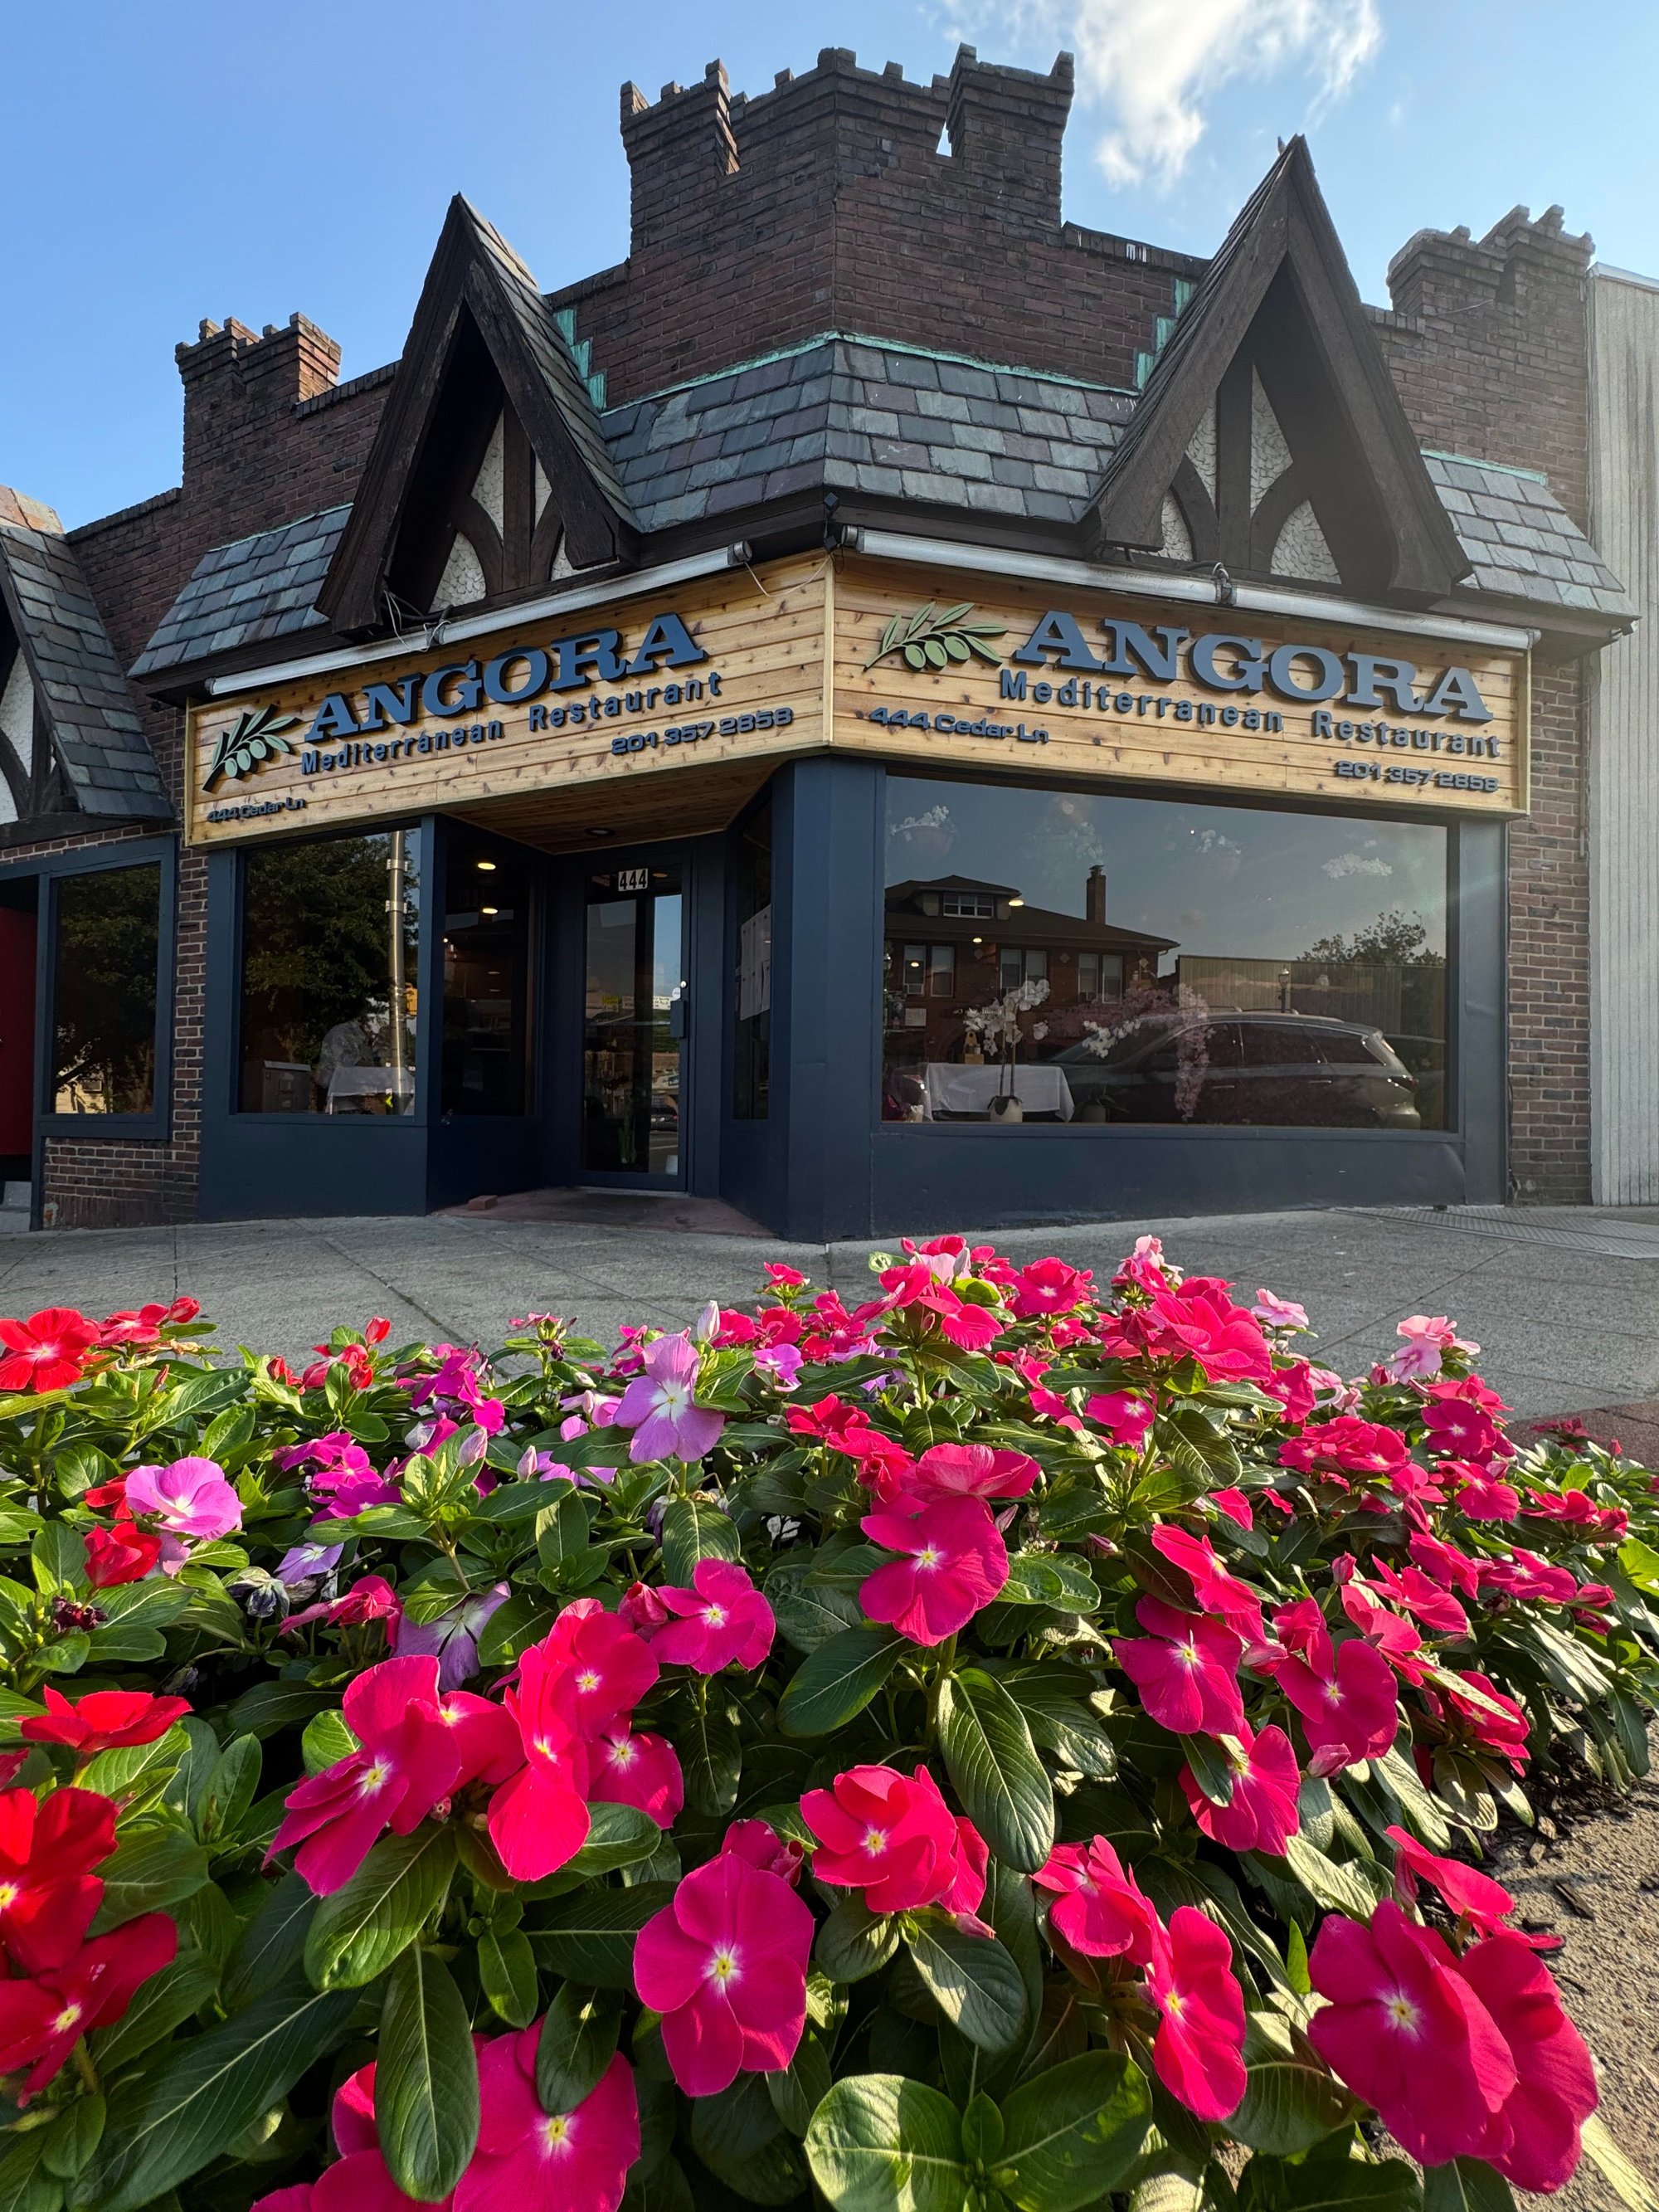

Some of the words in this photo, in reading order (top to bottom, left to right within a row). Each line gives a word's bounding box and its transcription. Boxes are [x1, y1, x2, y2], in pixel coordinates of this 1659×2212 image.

[304, 611, 708, 743] ANGORA
[1012, 610, 1494, 724] ANGORA
[301, 719, 504, 775] Mediterranean
[529, 671, 722, 732] Restaurant
[611, 731, 657, 755] 201
[664, 721, 714, 745] 357
[719, 707, 794, 735] 2858
[869, 707, 931, 728] 444
[935, 714, 1014, 738] Cedar
[1018, 723, 1049, 743] Ln
[1000, 669, 1283, 733] Mediterranean
[1311, 709, 1501, 758] Restaurant
[1335, 759, 1381, 780] 201
[1387, 766, 1435, 785] 357
[1437, 771, 1500, 792] 2858
[207, 806, 240, 823] 444
[240, 801, 285, 818] Cedar
[285, 797, 307, 811] Ln
[619, 869, 647, 890] 444
